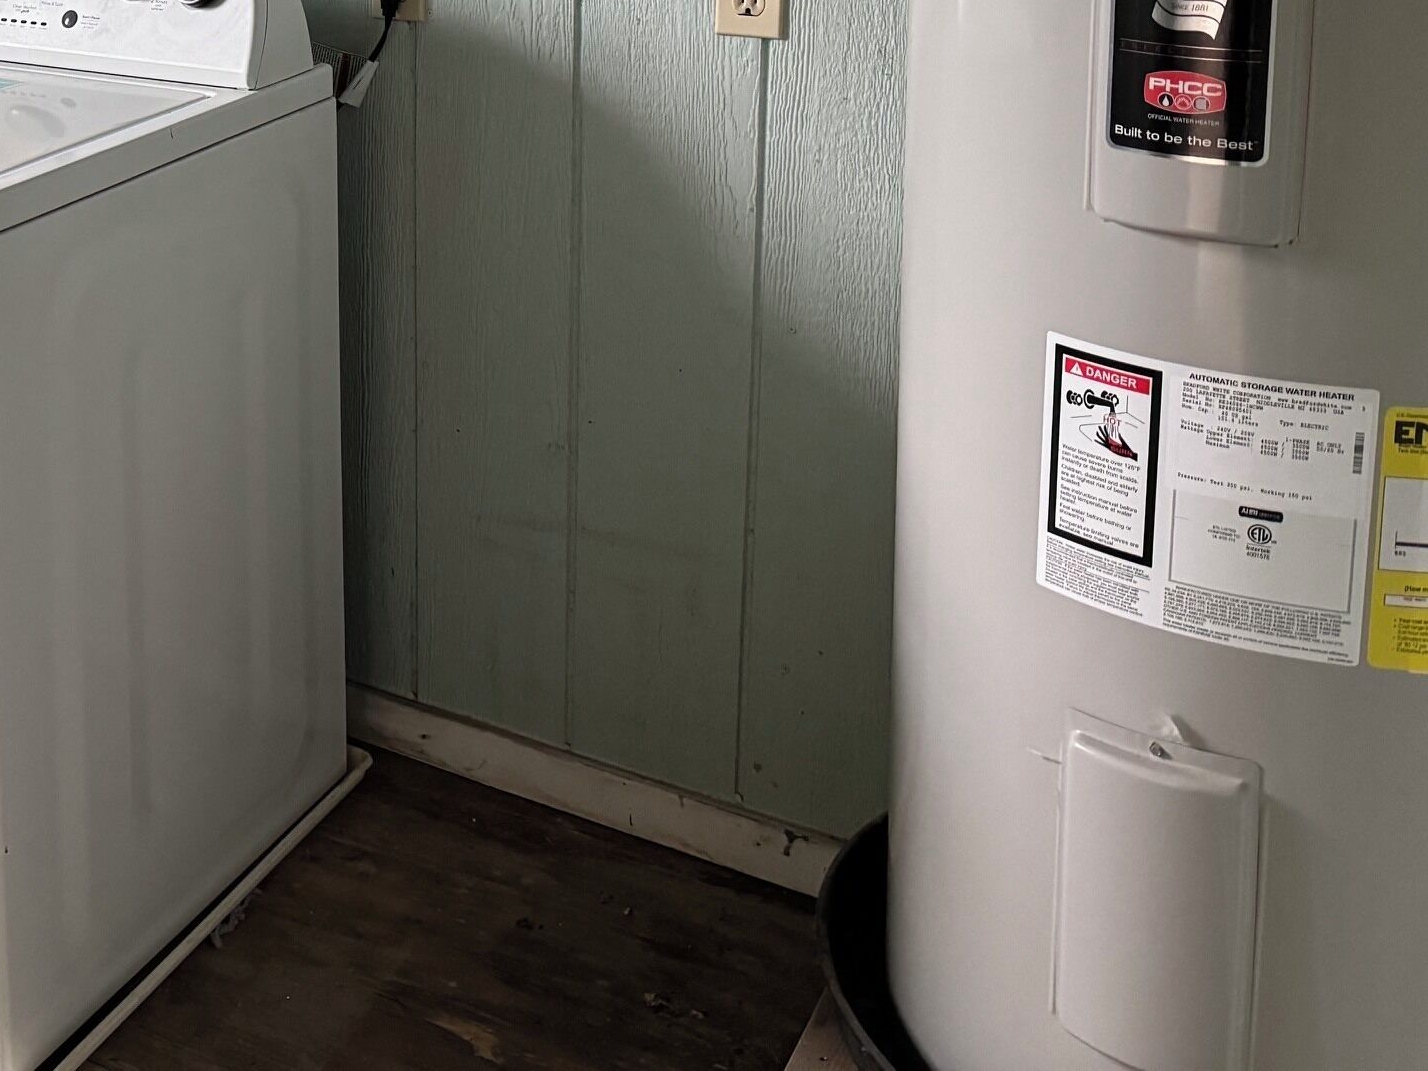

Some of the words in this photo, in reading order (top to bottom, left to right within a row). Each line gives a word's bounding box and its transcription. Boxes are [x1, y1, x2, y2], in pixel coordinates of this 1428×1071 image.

[1191, 4, 1209, 12] 1881
[1148, 77, 1222, 97] PHCC
[1147, 113, 1172, 122] OFFICIAL
[1173, 116, 1195, 124] WATER
[1195, 118, 1220, 126] HEATER
[1115, 124, 1142, 139] Built
[1146, 127, 1160, 142] to
[1164, 129, 1182, 144] be
[1188, 132, 1212, 148] the
[1217, 138, 1254, 151] Best
[1086, 366, 1137, 388] DANGER
[1189, 372, 1238, 386] AUTOMATIC
[1241, 381, 1283, 393] STORAGE
[1285, 387, 1316, 397] WATER
[1319, 391, 1355, 401] HEATER
[1103, 414, 1122, 427] HOT
[1061, 456, 1081, 468] instantly
[1090, 465, 1104, 475] death
[1073, 453, 1087, 462] cause
[1088, 459, 1106, 469] severe
[1078, 449, 1109, 463] temperature
[1076, 475, 1095, 486] highest
[1113, 487, 1128, 496] being
[1119, 484, 1138, 493] elderly
[1060, 491, 1076, 500] setting
[1078, 496, 1109, 510] temperature
[1071, 488, 1098, 501] instruction
[1098, 498, 1118, 508] manual
[1120, 503, 1138, 513] before
[1071, 507, 1085, 516] water
[1086, 512, 1103, 522] before
[1104, 518, 1124, 529] bathing
[1060, 516, 1090, 532] Temperature
[1112, 536, 1128, 545] valves
[1252, 528, 1268, 543] ETL
[1246, 544, 1271, 554] Intertek
